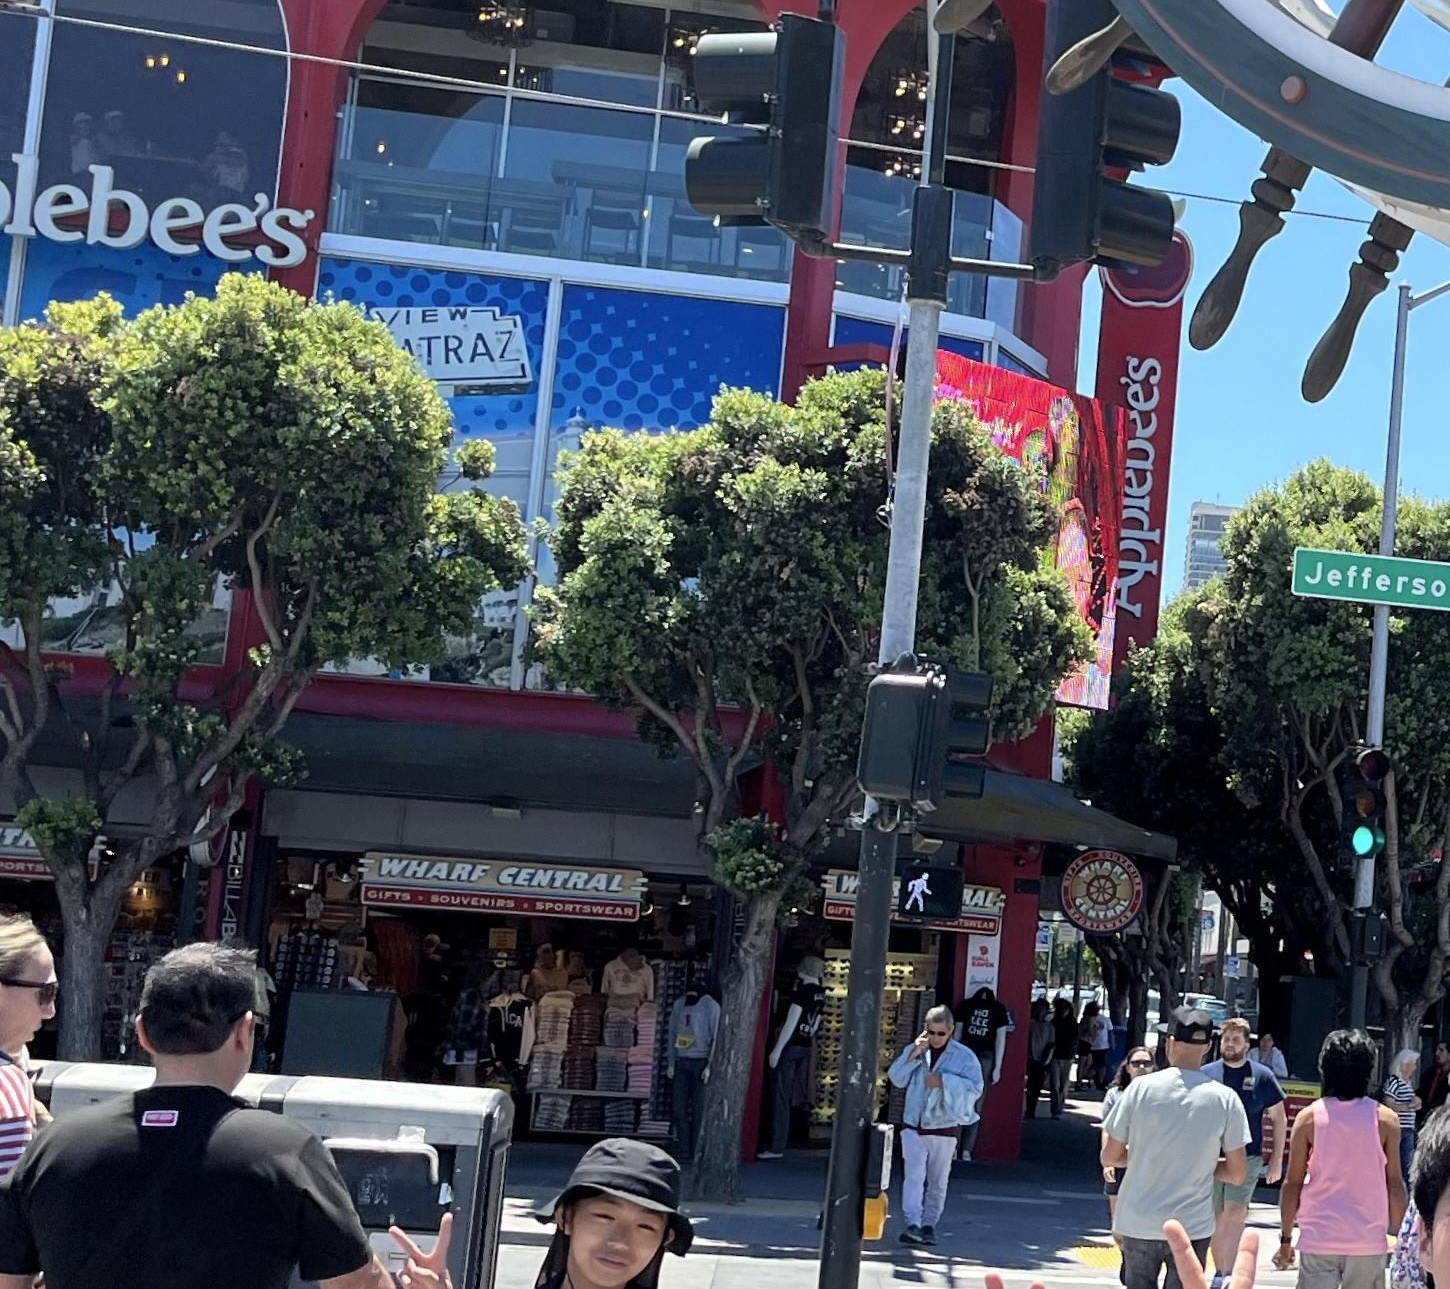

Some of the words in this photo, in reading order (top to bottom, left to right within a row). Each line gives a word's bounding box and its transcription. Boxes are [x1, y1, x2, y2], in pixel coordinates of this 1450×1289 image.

[0, 153, 310, 267] lebee's
[375, 308, 468, 325] VIEW
[401, 330, 514, 365] ATRAZ
[1115, 356, 1162, 618] Applebee's
[379, 857, 491, 882] WHARF
[497, 866, 625, 893] CENTRAL
[221, 865, 245, 940] BILLAB
[367, 889, 411, 902] GIFTS
[430, 893, 516, 909] SOUVENIRS
[535, 901, 635, 917] SPORTSWEAR
[971, 1018, 989, 1027] LEE
